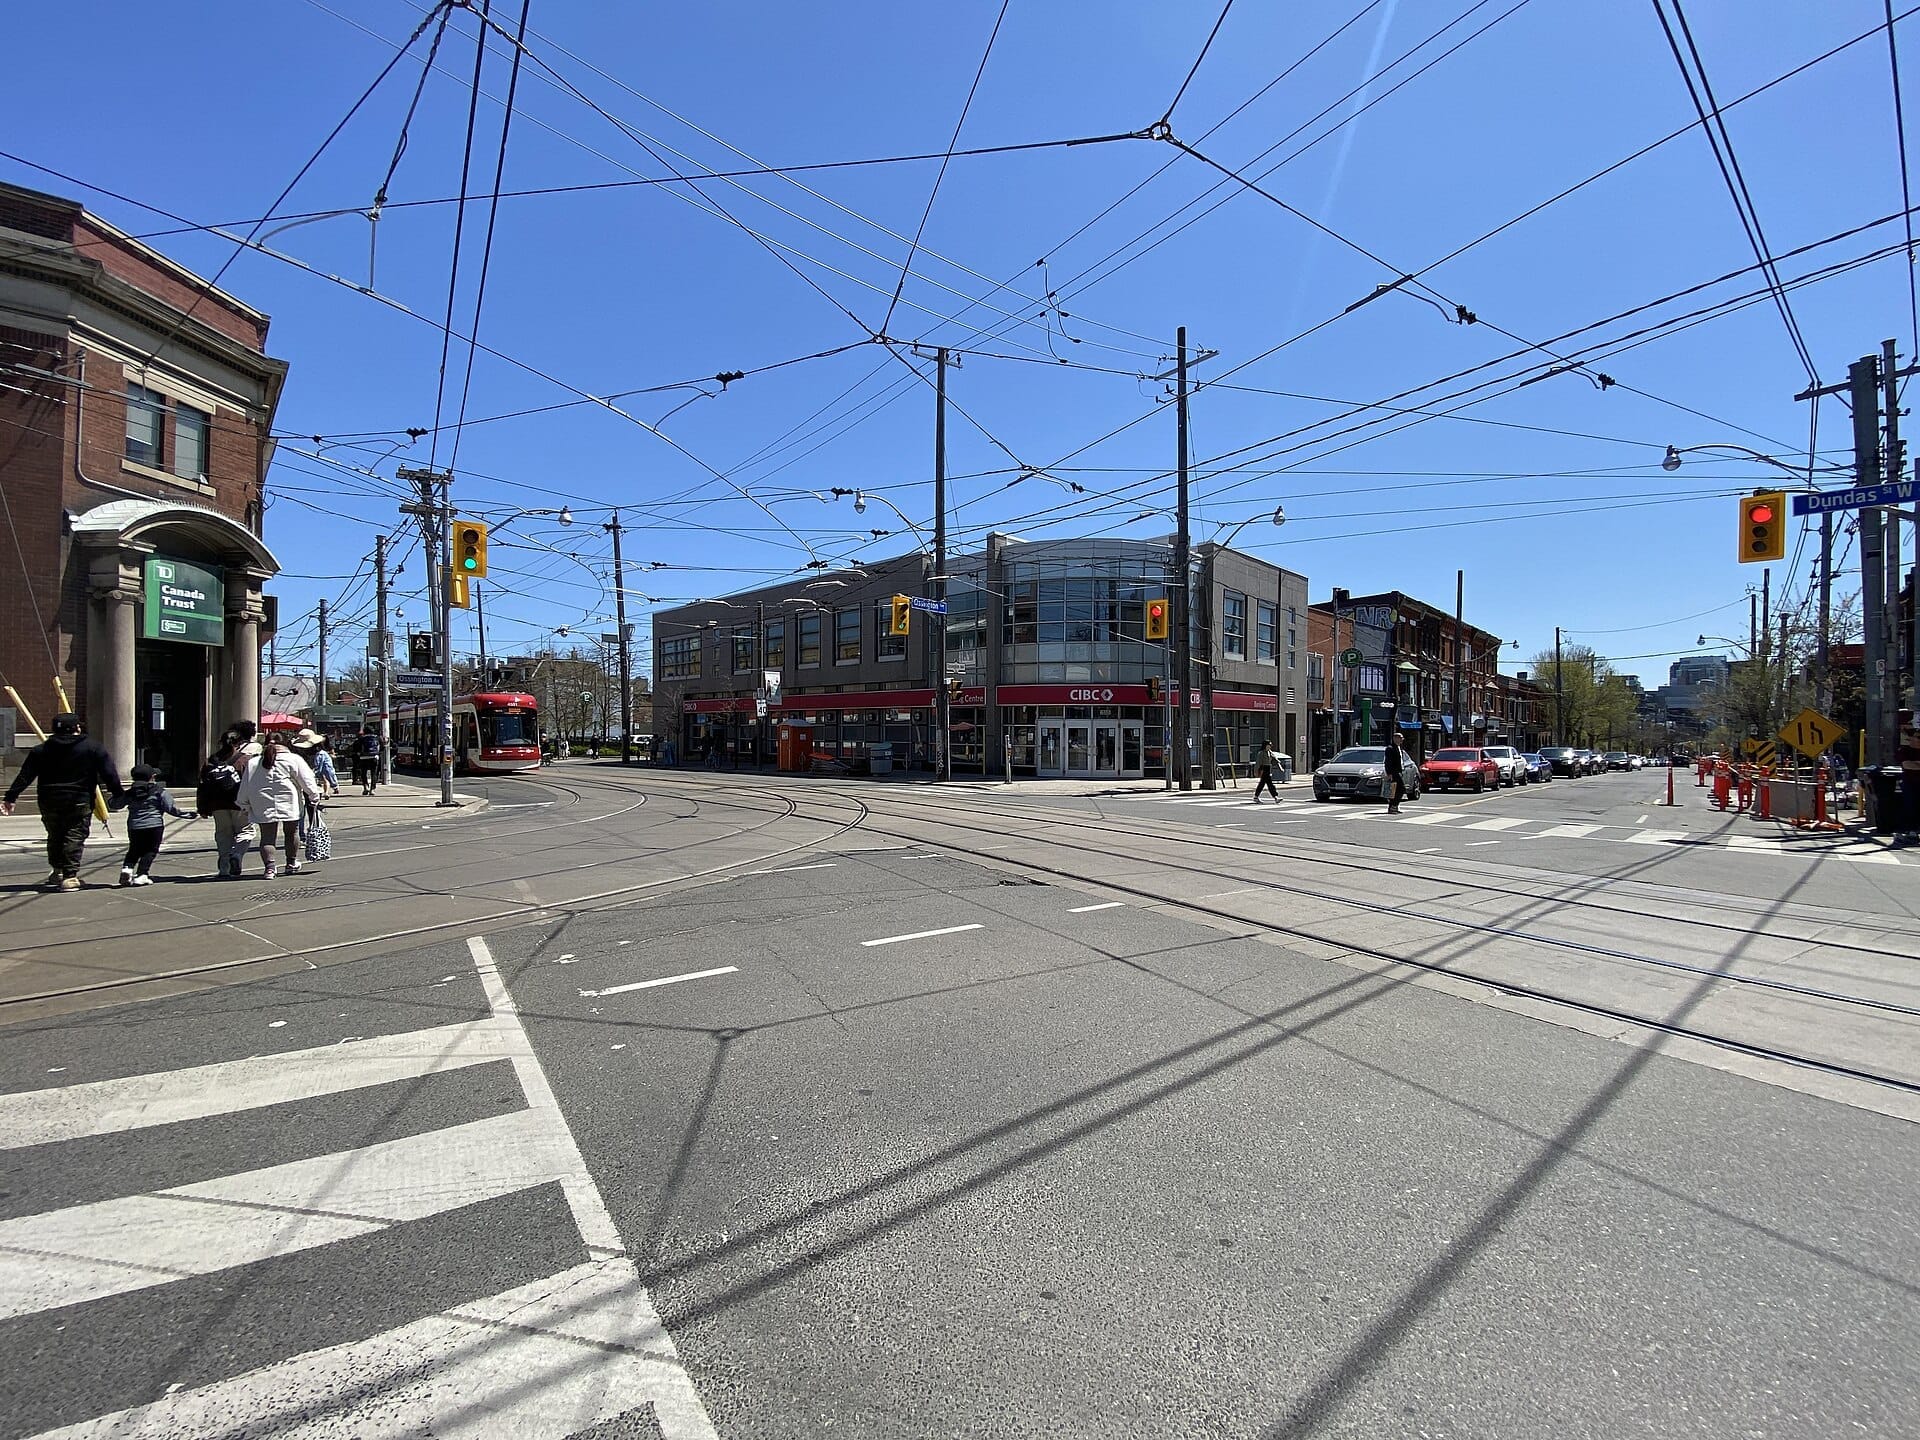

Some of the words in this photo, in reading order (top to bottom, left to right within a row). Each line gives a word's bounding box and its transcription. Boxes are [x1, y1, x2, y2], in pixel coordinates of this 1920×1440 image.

[1808, 490, 1878, 510] Dundas
[1882, 486, 1893, 495] St
[1896, 482, 1913, 498] W
[155, 565, 173, 579] TD
[161, 584, 206, 600] Canada
[161, 595, 195, 610] Trust
[964, 694, 984, 703] Centre
[1070, 689, 1100, 701] CIBC
